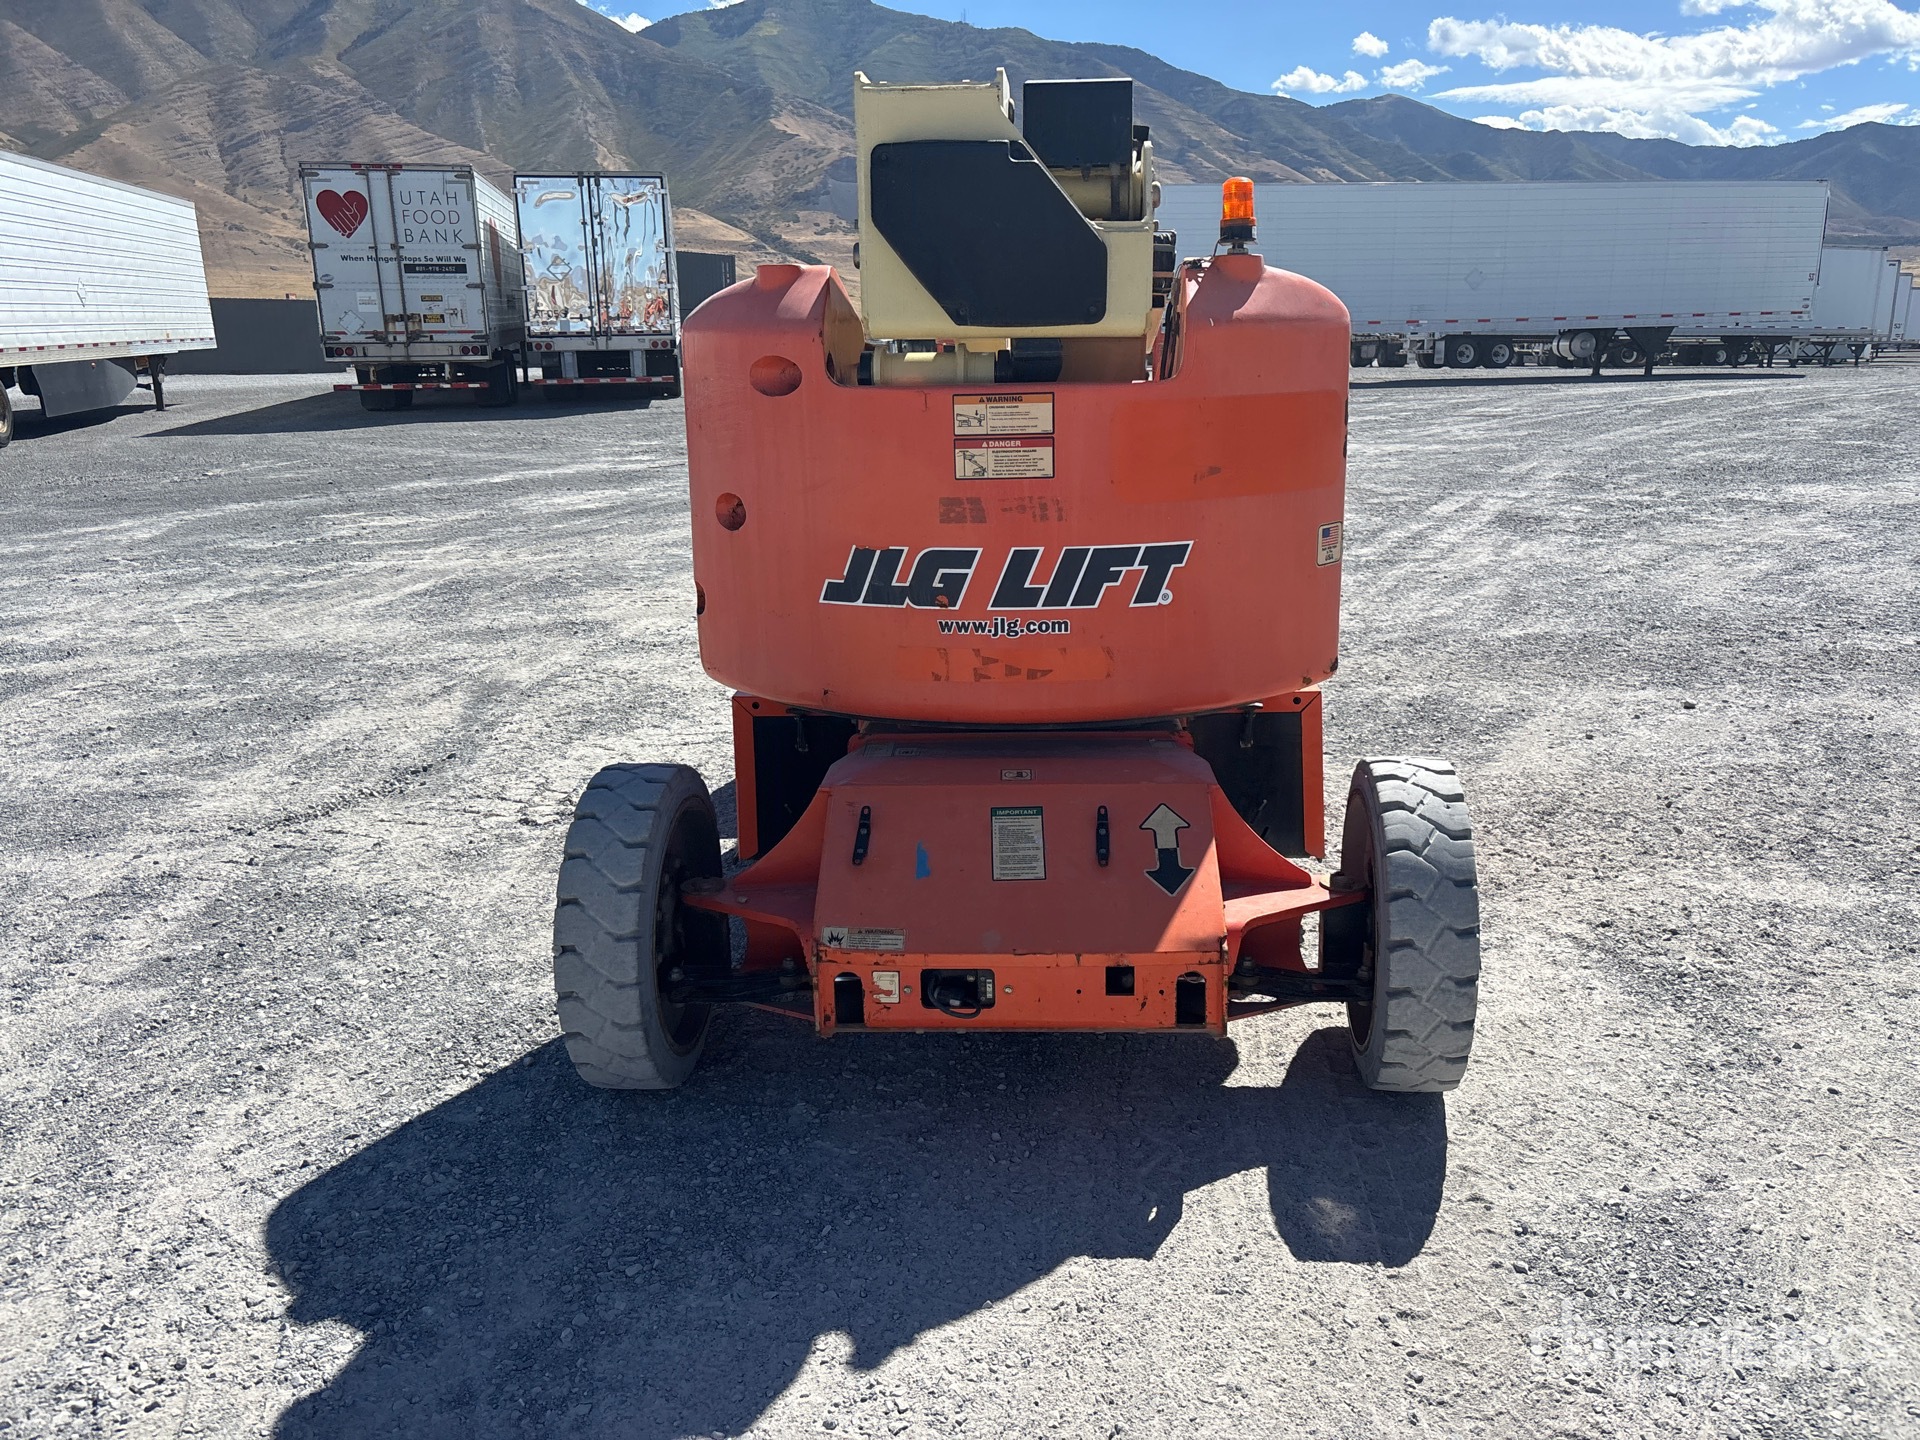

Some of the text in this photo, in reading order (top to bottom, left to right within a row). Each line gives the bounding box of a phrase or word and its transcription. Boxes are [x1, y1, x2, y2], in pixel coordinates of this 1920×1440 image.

[399, 190, 458, 206] UTAH
[402, 209, 460, 225] FOOD
[404, 228, 464, 243] BANK
[340, 254, 364, 262] When
[366, 255, 398, 263] Hunger
[400, 255, 422, 263] Stops
[423, 255, 434, 263] So
[435, 255, 452, 263] Will
[986, 395, 1024, 403] WARNING
[988, 440, 1022, 448] DANGER
[819, 541, 1194, 610] JLG LIFT
[937, 617, 1070, 638] www.jlg.com
